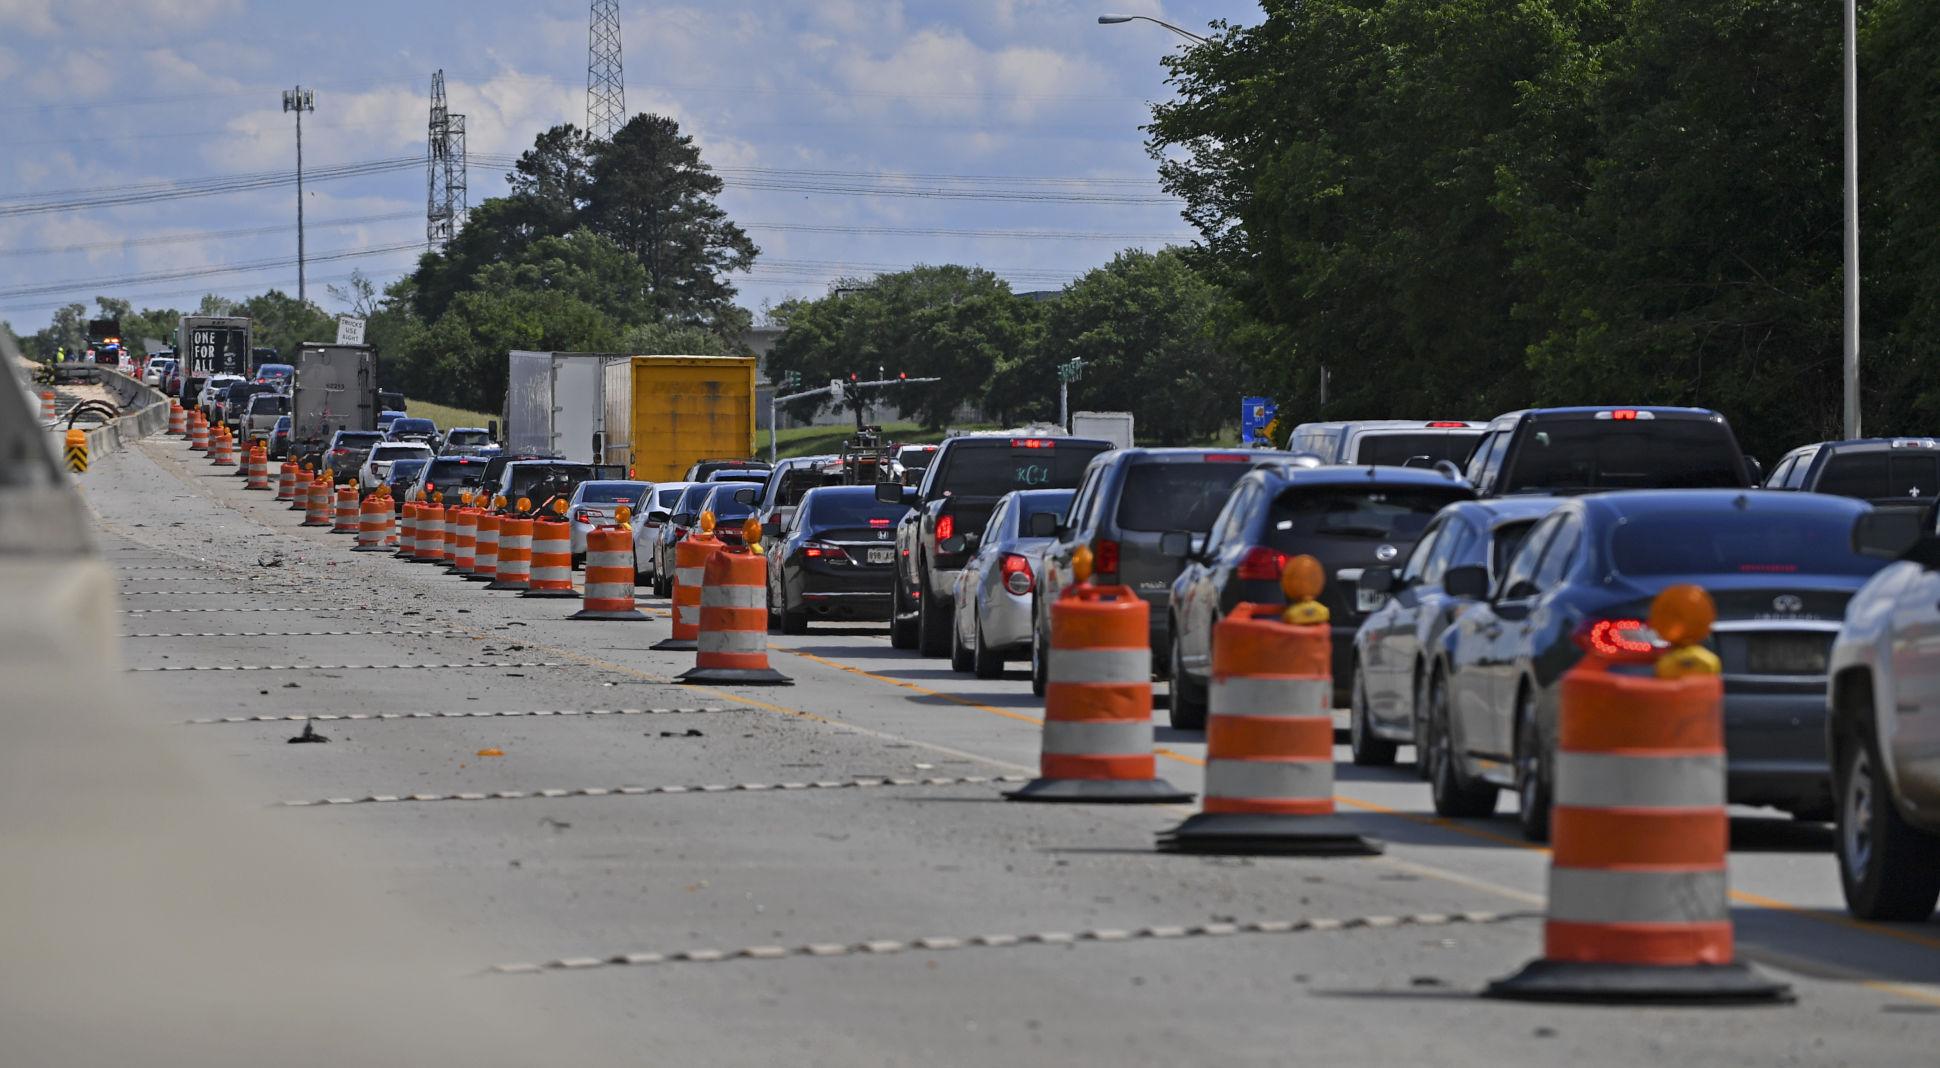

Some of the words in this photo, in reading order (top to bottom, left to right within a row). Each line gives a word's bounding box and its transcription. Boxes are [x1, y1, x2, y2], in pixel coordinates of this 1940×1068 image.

[345, 327, 357, 335] USE
[194, 332, 215, 344] ONE
[194, 345, 215, 358] FOR
[194, 359, 215, 371] ALL
